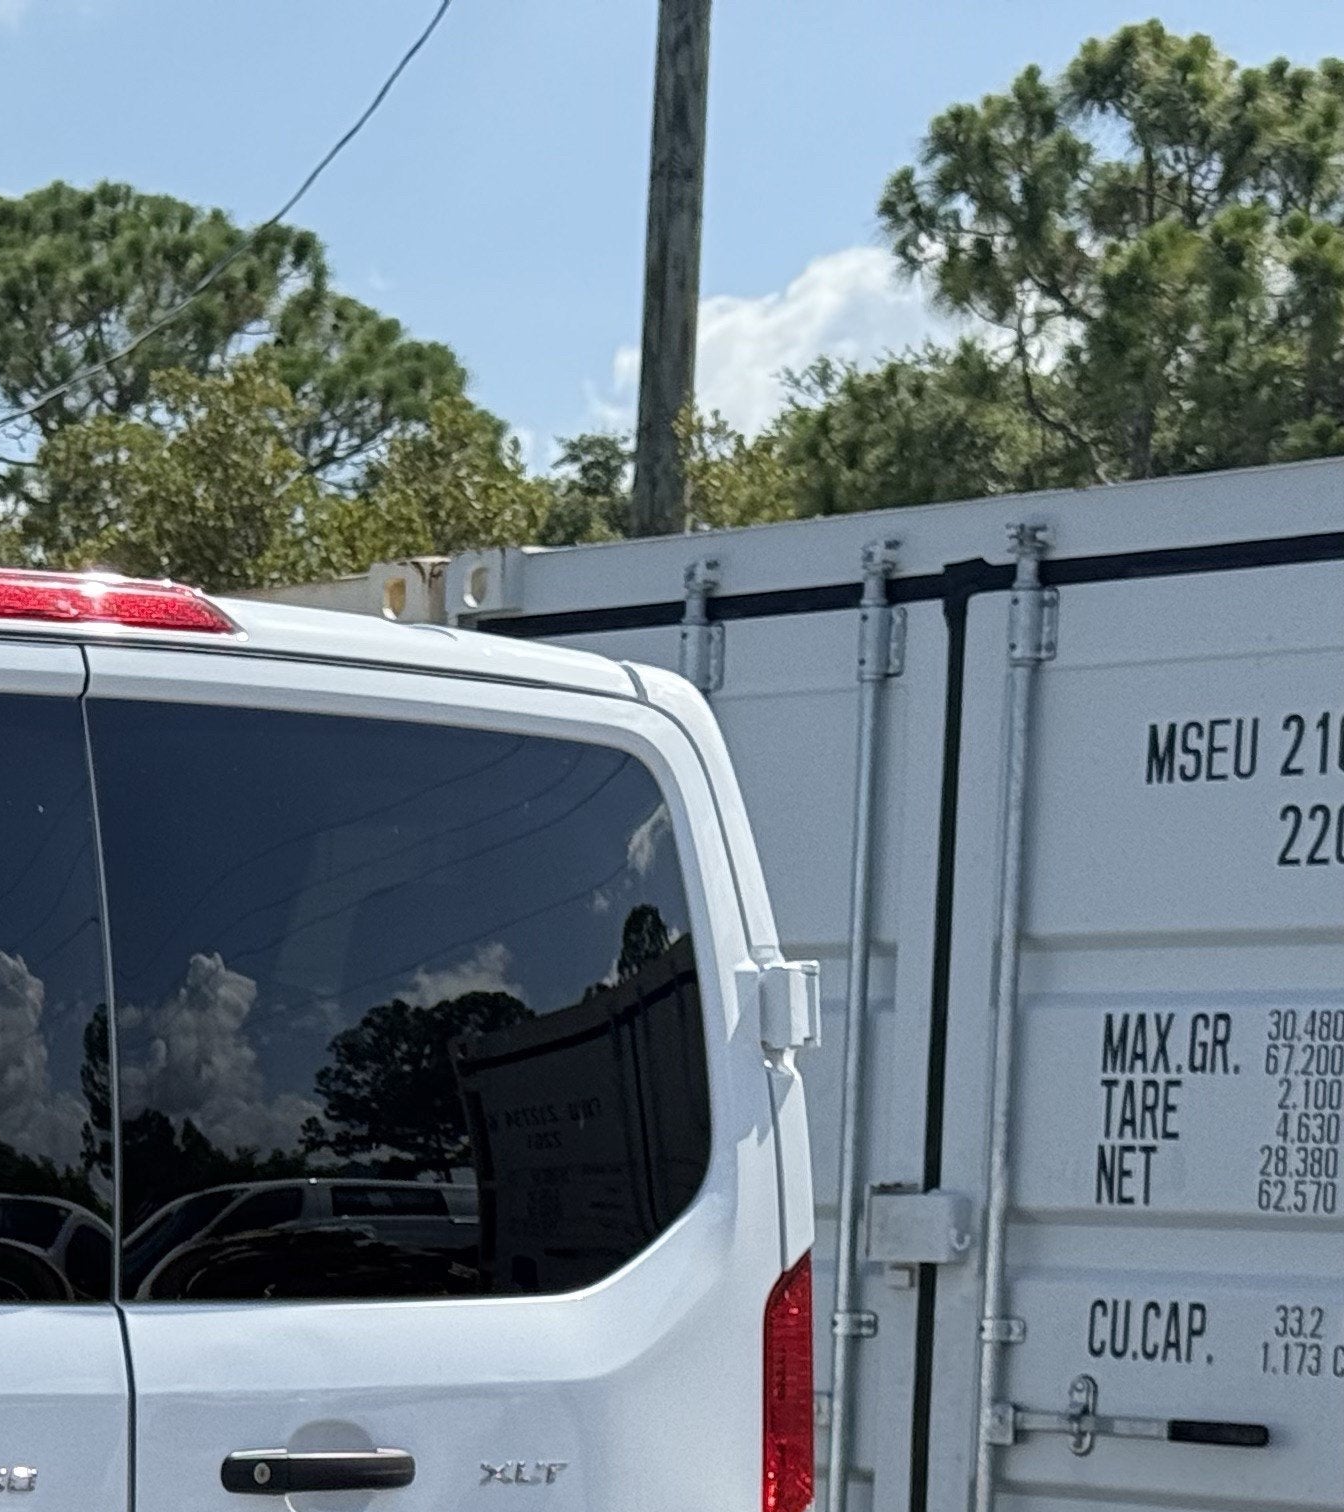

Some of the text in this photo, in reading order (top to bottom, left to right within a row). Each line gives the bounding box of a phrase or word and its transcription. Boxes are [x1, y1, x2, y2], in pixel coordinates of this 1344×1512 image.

[1146, 717, 1260, 785] MSEU
[1102, 1008, 1344, 1075] MAX.GR. 30.480
[1265, 1043, 1344, 1076] 67.200
[1101, 1077, 1343, 1140] TARE 2.100
[1276, 1111, 1341, 1145] 4.630
[1095, 1144, 1339, 1206] NET 28.380
[1258, 1179, 1337, 1214] 62.570
[1088, 1299, 1324, 1363] CU.CAP. 33.2
[1263, 1341, 1322, 1377] 1.173
[479, 1461, 569, 1487] XLT
